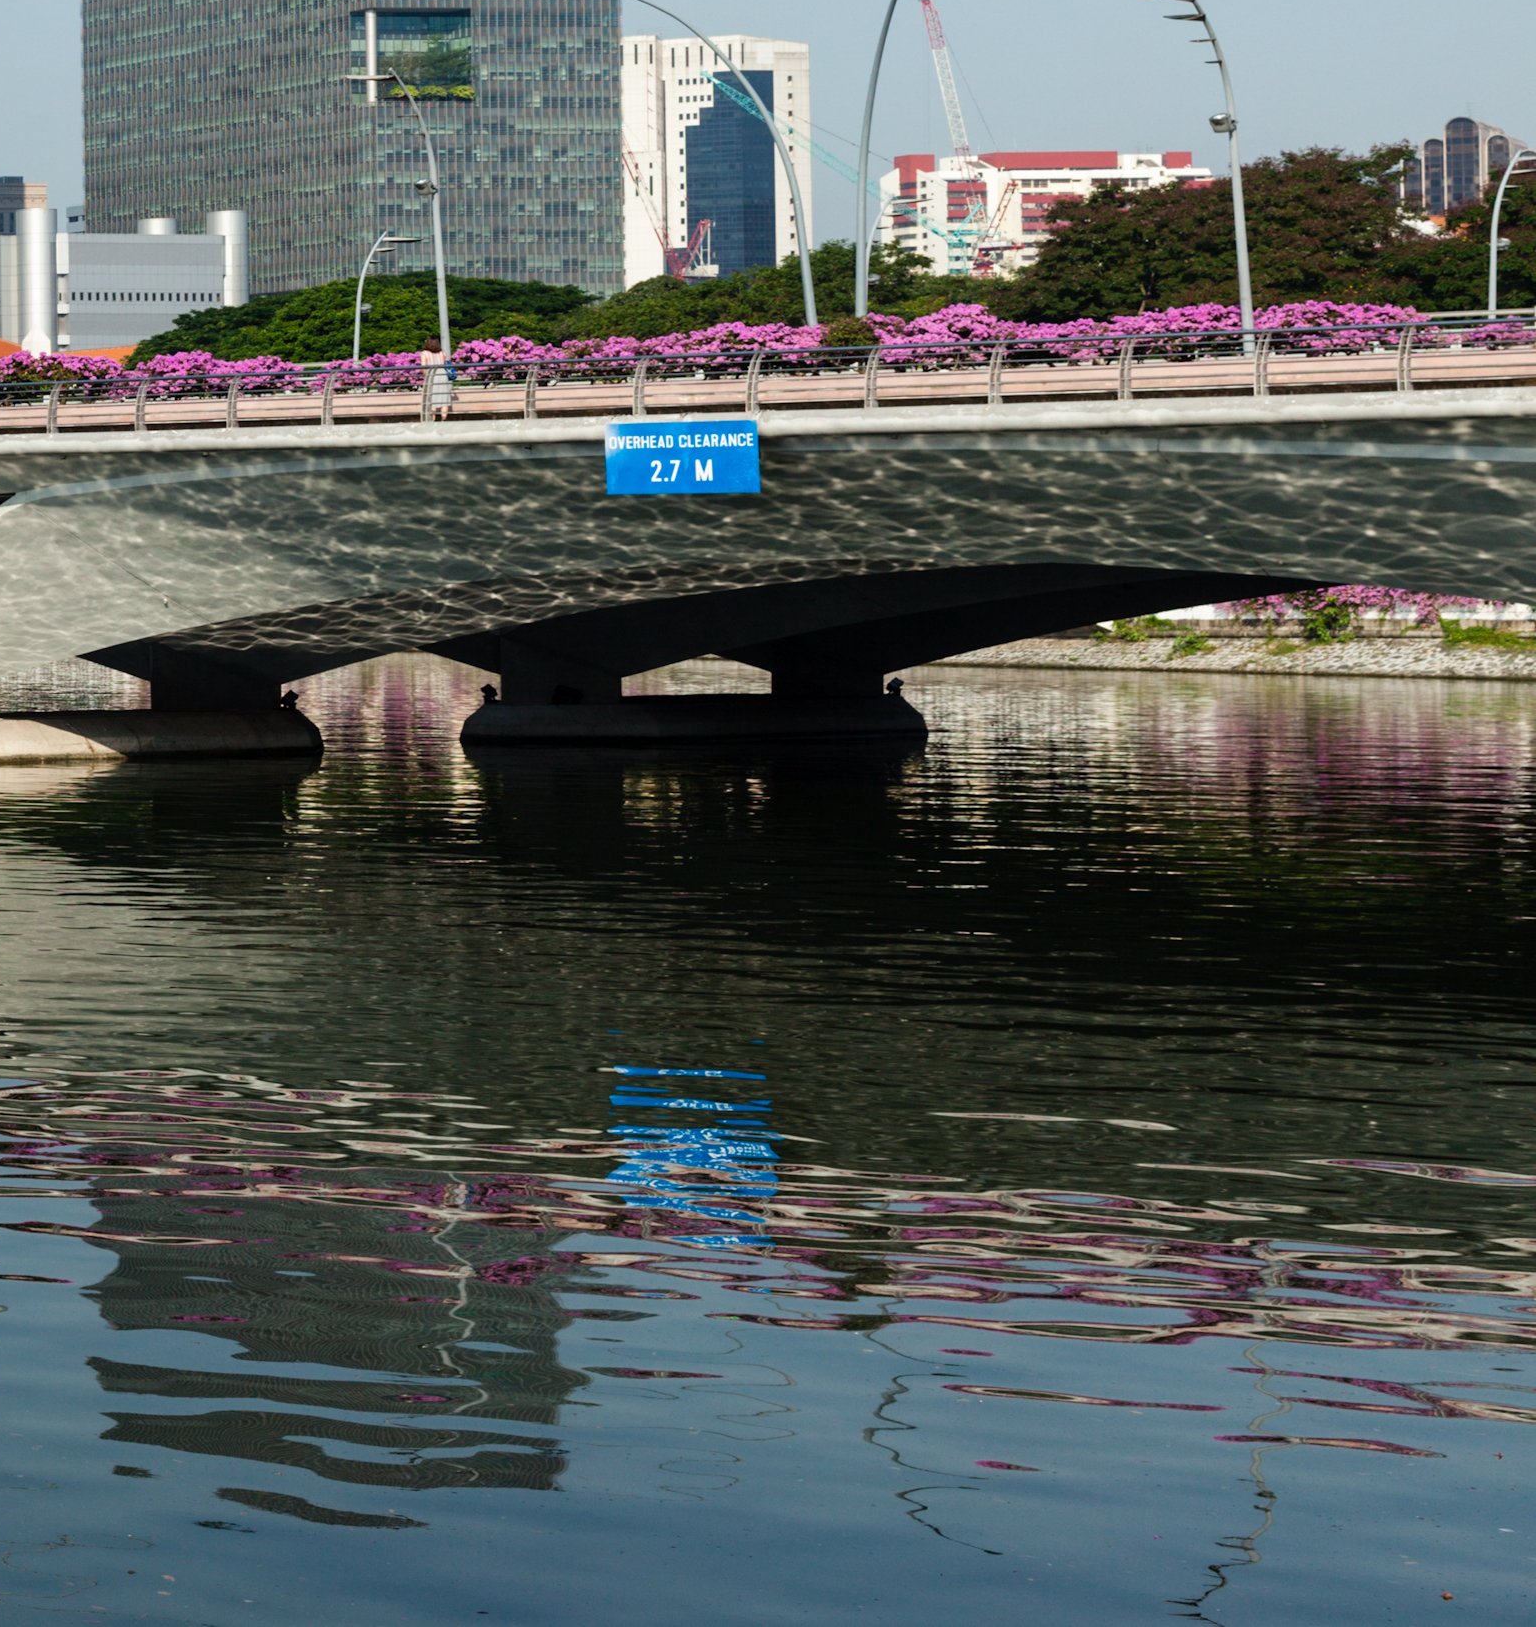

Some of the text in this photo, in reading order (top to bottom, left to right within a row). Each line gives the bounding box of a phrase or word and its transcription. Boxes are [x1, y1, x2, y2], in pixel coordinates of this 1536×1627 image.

[609, 432, 754, 450] OVERHEAD CLEARANCE
[650, 458, 714, 483] 2.7 M
